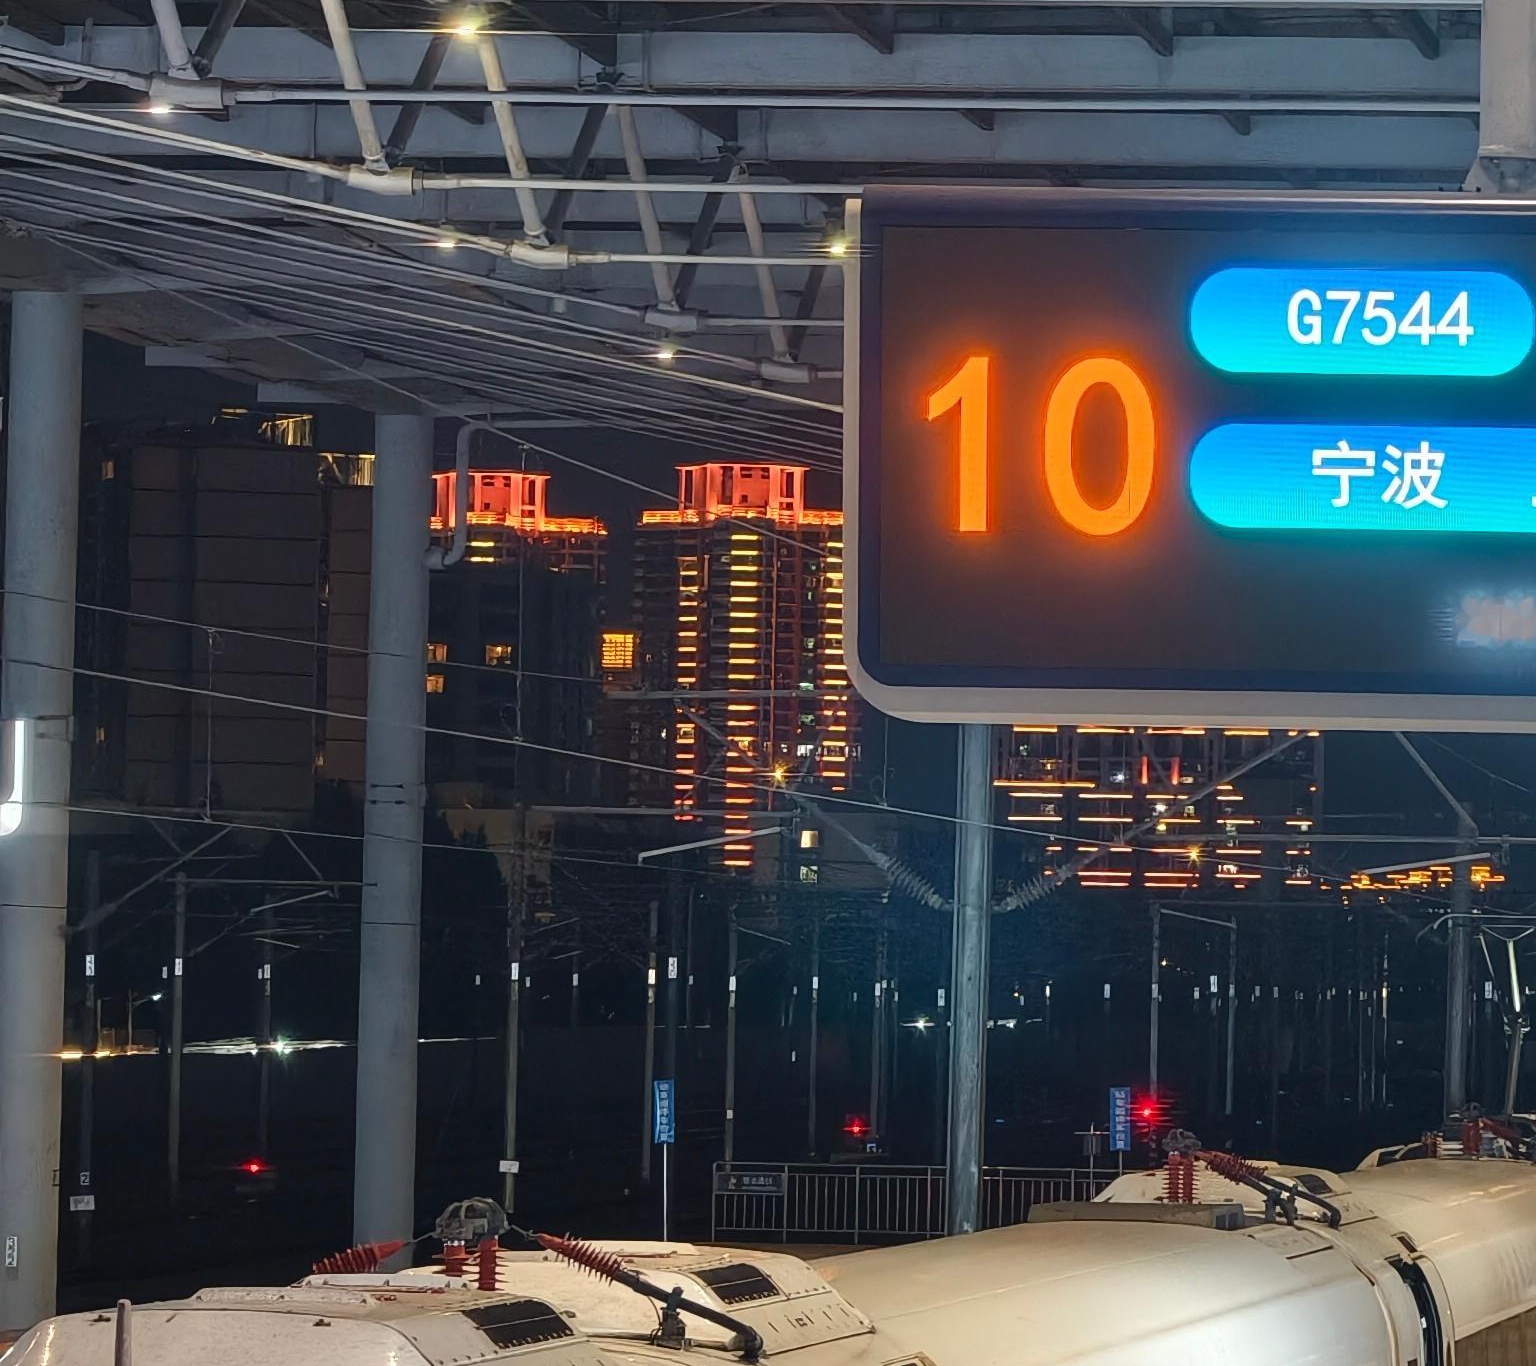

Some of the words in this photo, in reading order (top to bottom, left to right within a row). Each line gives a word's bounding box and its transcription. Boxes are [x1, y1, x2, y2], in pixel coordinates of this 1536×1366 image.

[1289, 290, 1473, 346] G7544
[927, 354, 1157, 536] 10
[1312, 441, 1448, 509] 宁波
